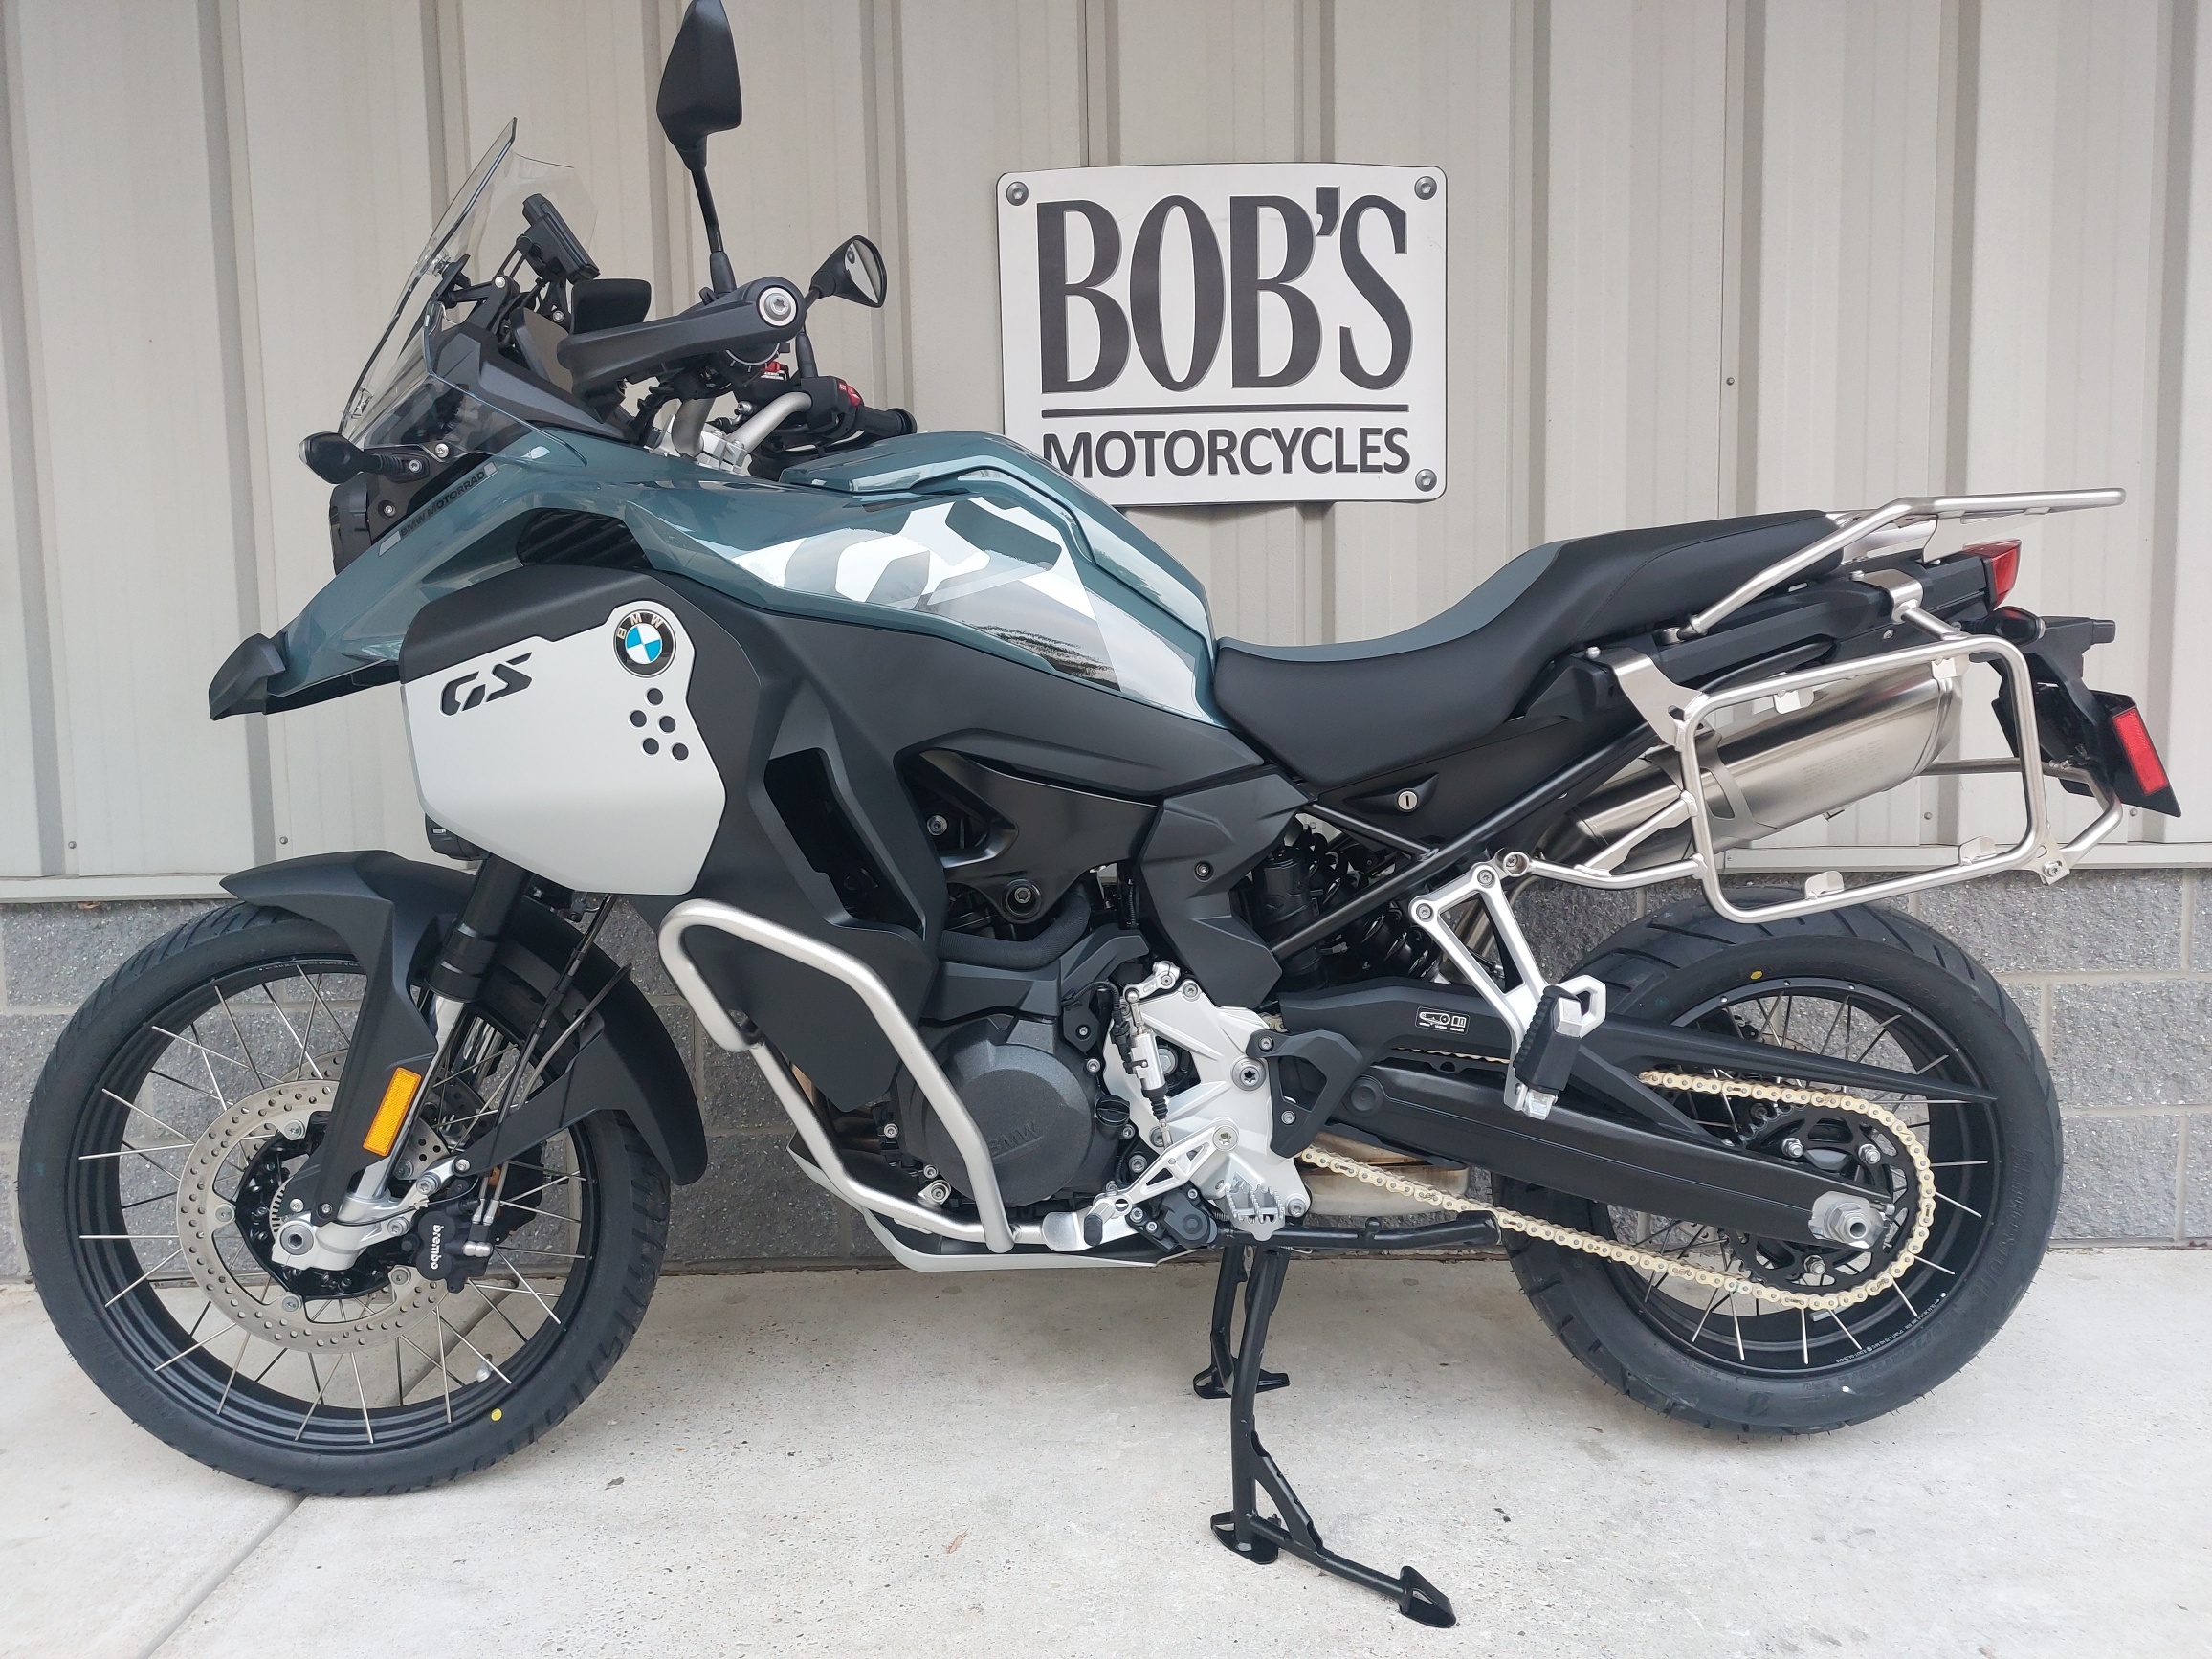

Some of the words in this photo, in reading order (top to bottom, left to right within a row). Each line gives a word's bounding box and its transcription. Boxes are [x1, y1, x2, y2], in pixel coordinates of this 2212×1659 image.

[1036, 186, 1413, 394] BOB'S
[1042, 427, 1411, 478] MOTORCYCLES
[400, 513, 426, 538] BMW
[428, 471, 485, 516] MOTORRAD
[617, 612, 663, 640] BMW
[440, 652, 533, 716] GS
[988, 1120, 1037, 1151] BMW
[431, 1225, 444, 1270] brembo
